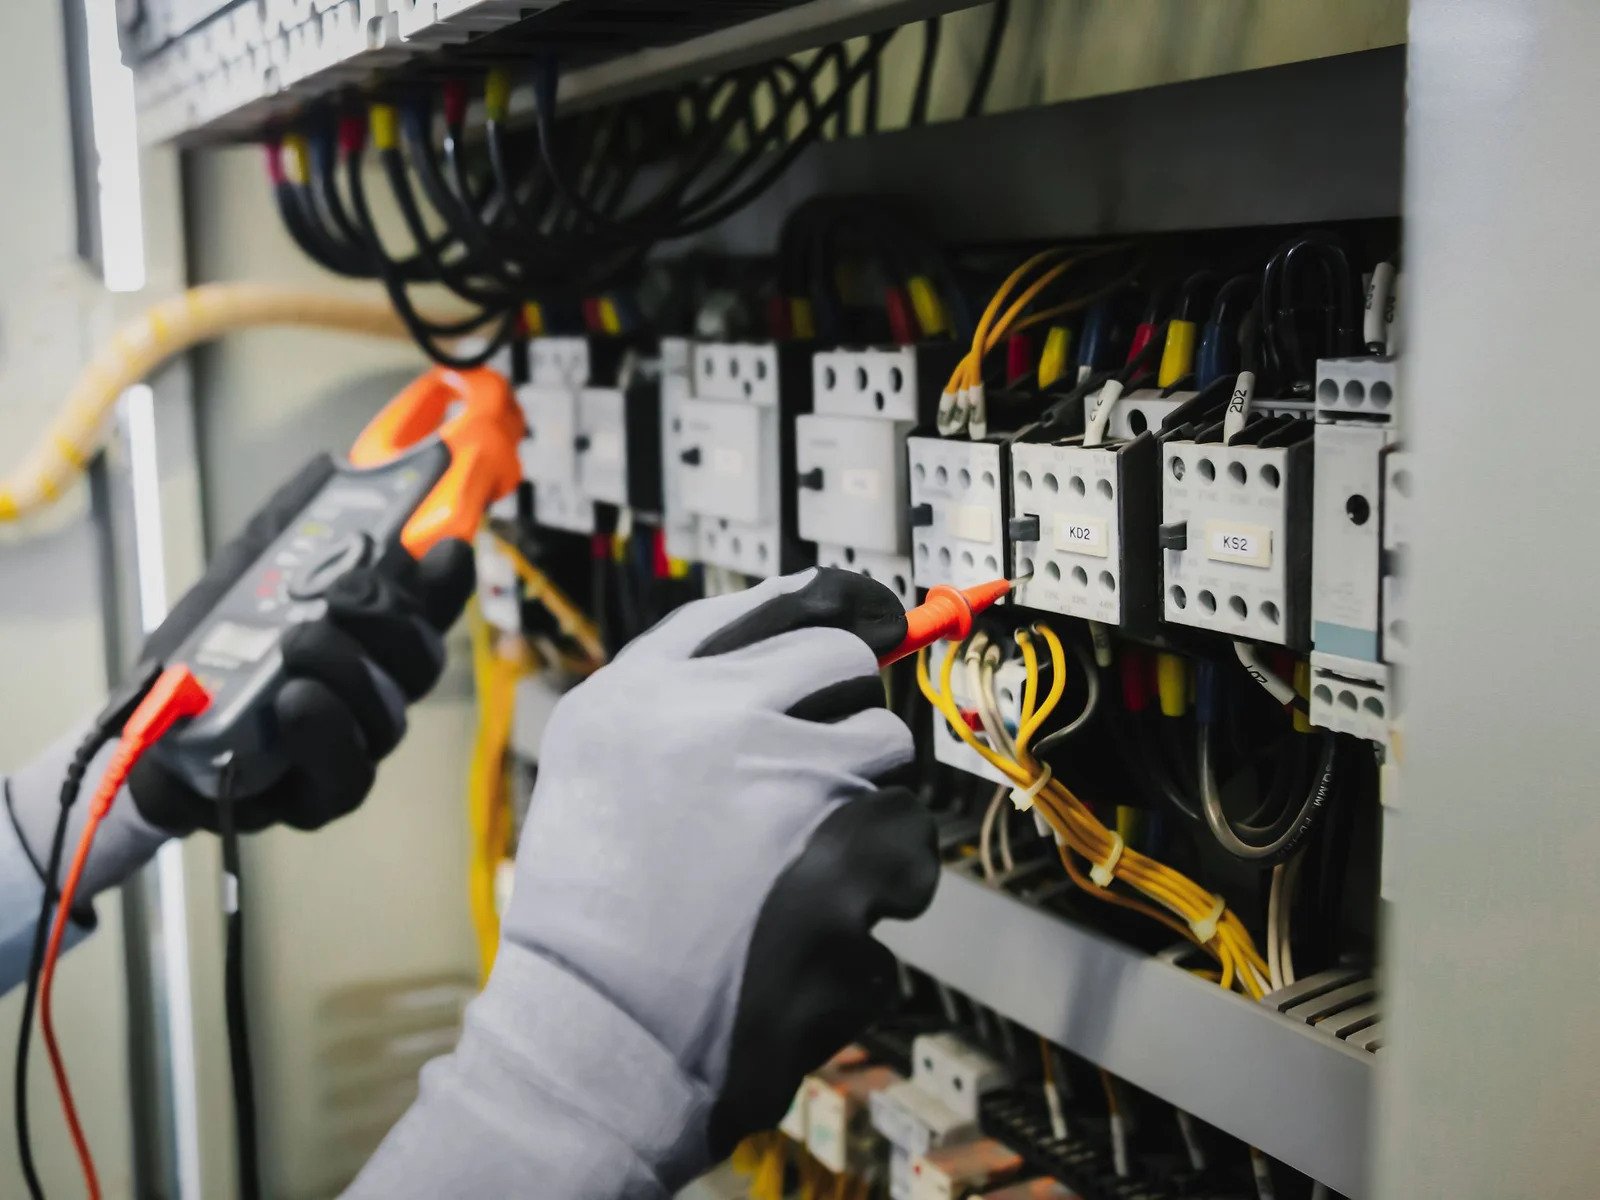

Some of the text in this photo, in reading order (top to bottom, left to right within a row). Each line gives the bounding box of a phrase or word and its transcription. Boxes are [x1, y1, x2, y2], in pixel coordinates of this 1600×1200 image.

[1229, 389, 1248, 413] 2D2
[1068, 526, 1091, 541] KD2
[1223, 535, 1248, 552] KS2
